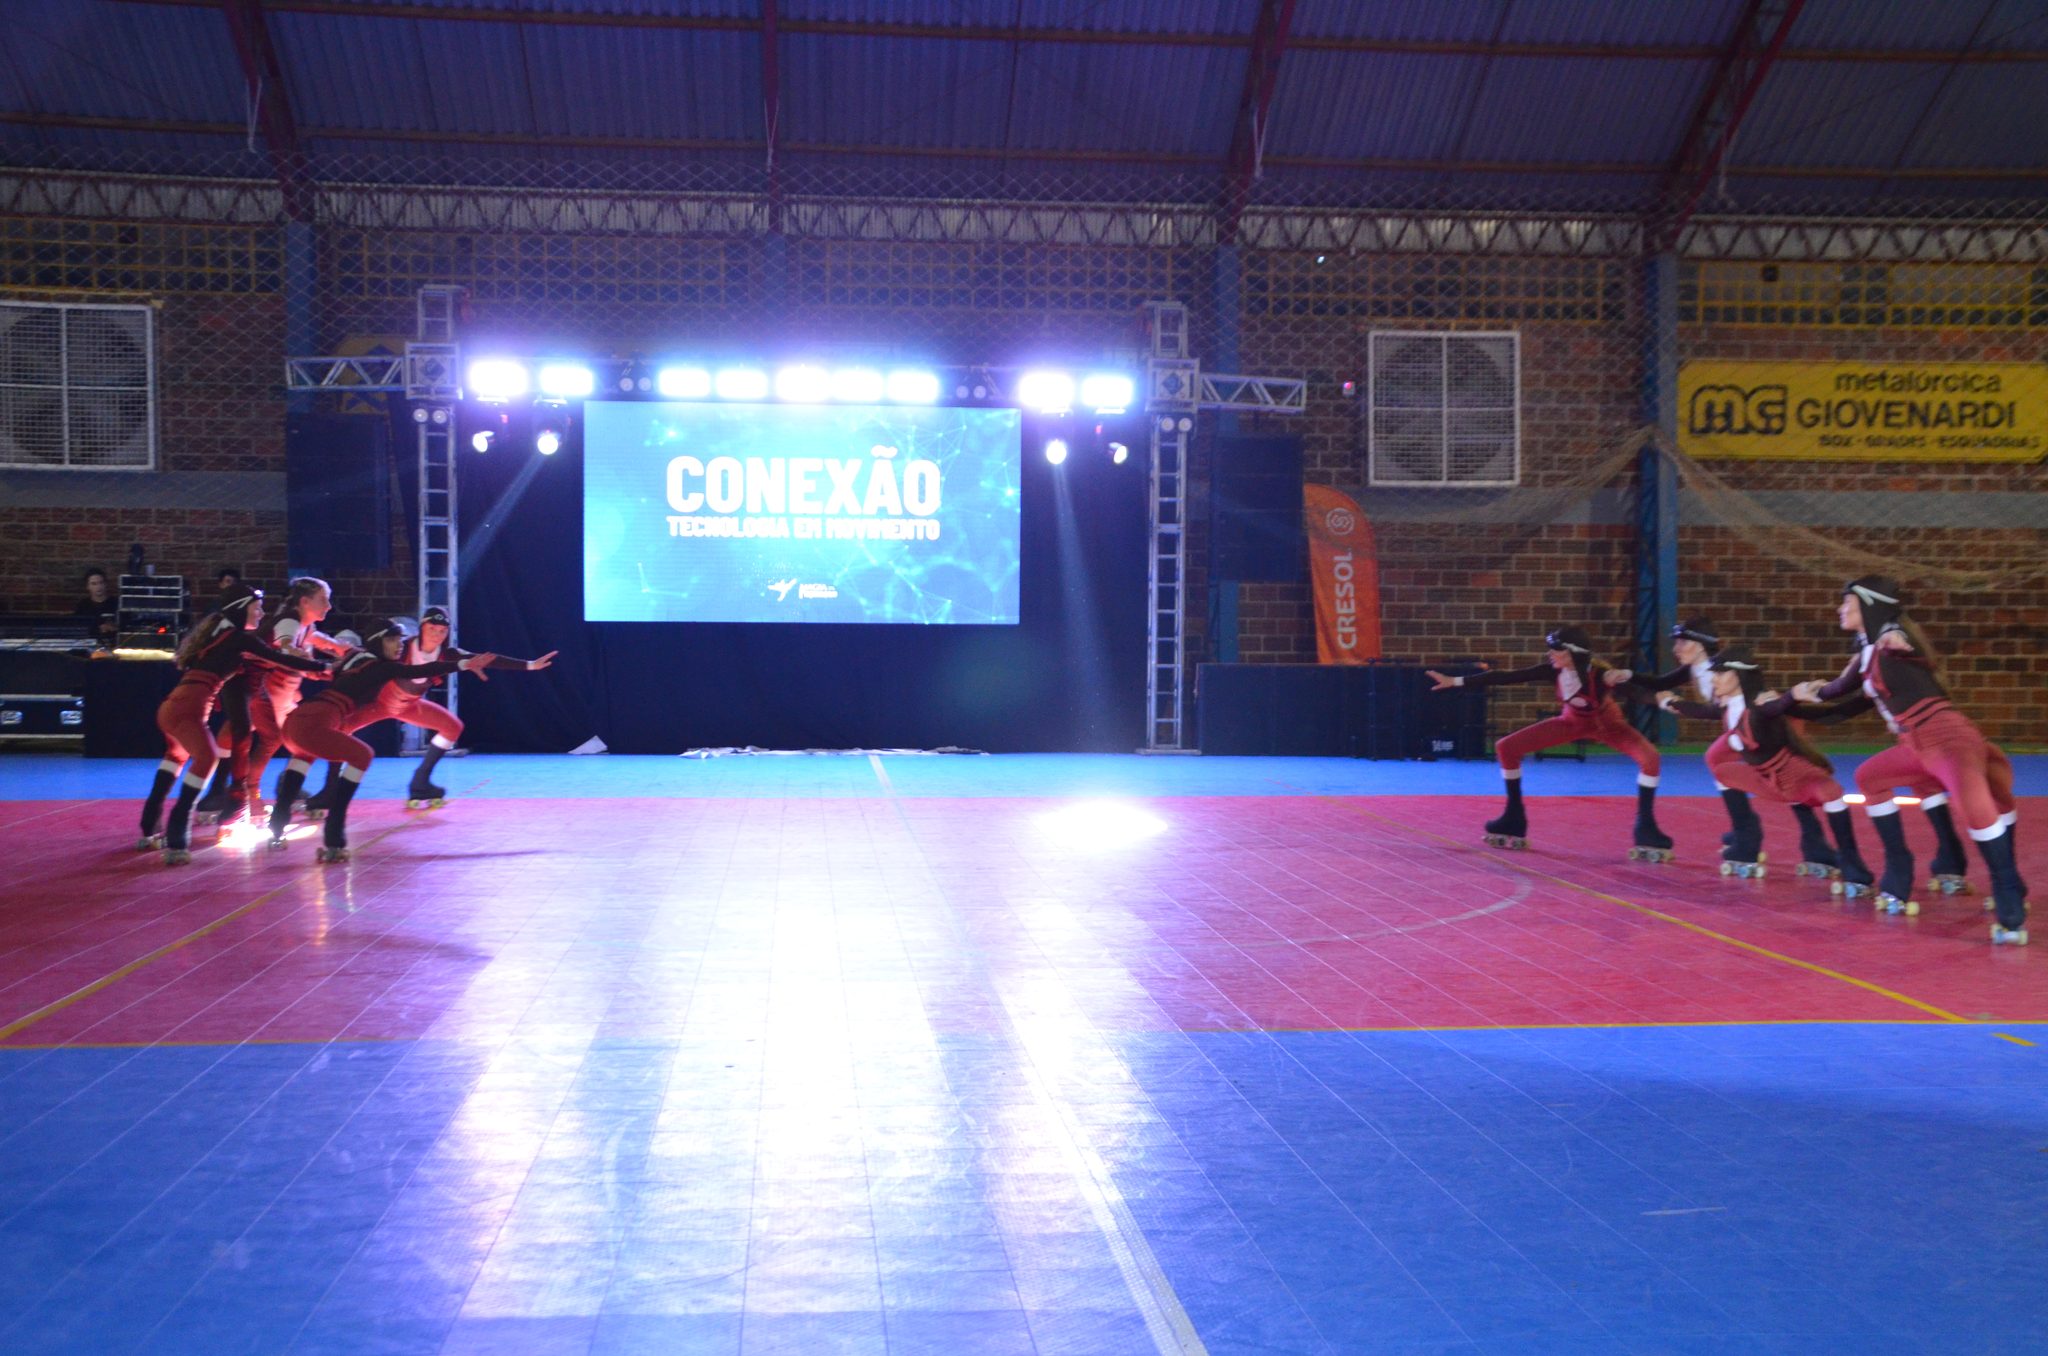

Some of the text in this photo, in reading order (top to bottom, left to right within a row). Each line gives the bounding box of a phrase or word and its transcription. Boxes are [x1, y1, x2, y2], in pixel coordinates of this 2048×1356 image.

[1797, 399, 2015, 429] GIOVENARDI
[667, 445, 941, 516] CONEXÃO
[667, 516, 940, 541] TECNOLOGIA EM MOVIMENTO
[1333, 549, 1357, 649] CRESOL
